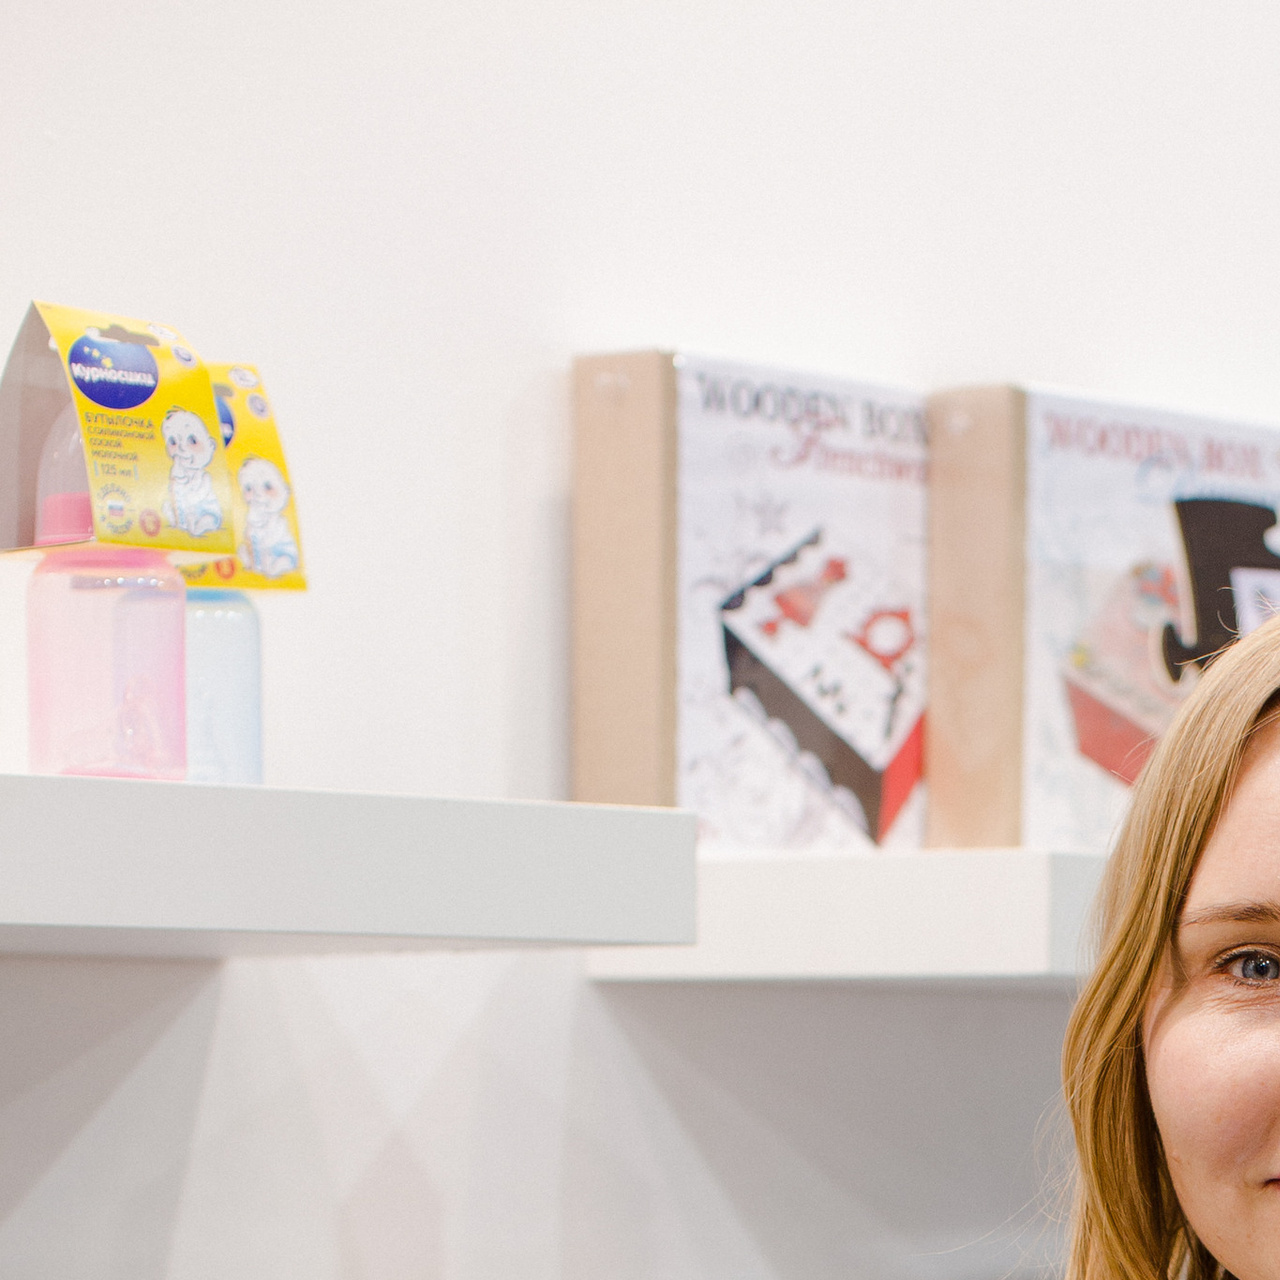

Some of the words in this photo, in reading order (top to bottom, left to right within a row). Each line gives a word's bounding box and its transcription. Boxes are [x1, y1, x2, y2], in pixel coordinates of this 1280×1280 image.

[695, 371, 848, 432] WOODEN
[84, 411, 154, 429] БУТЫЛОЧКА
[101, 463, 117, 475] 125
